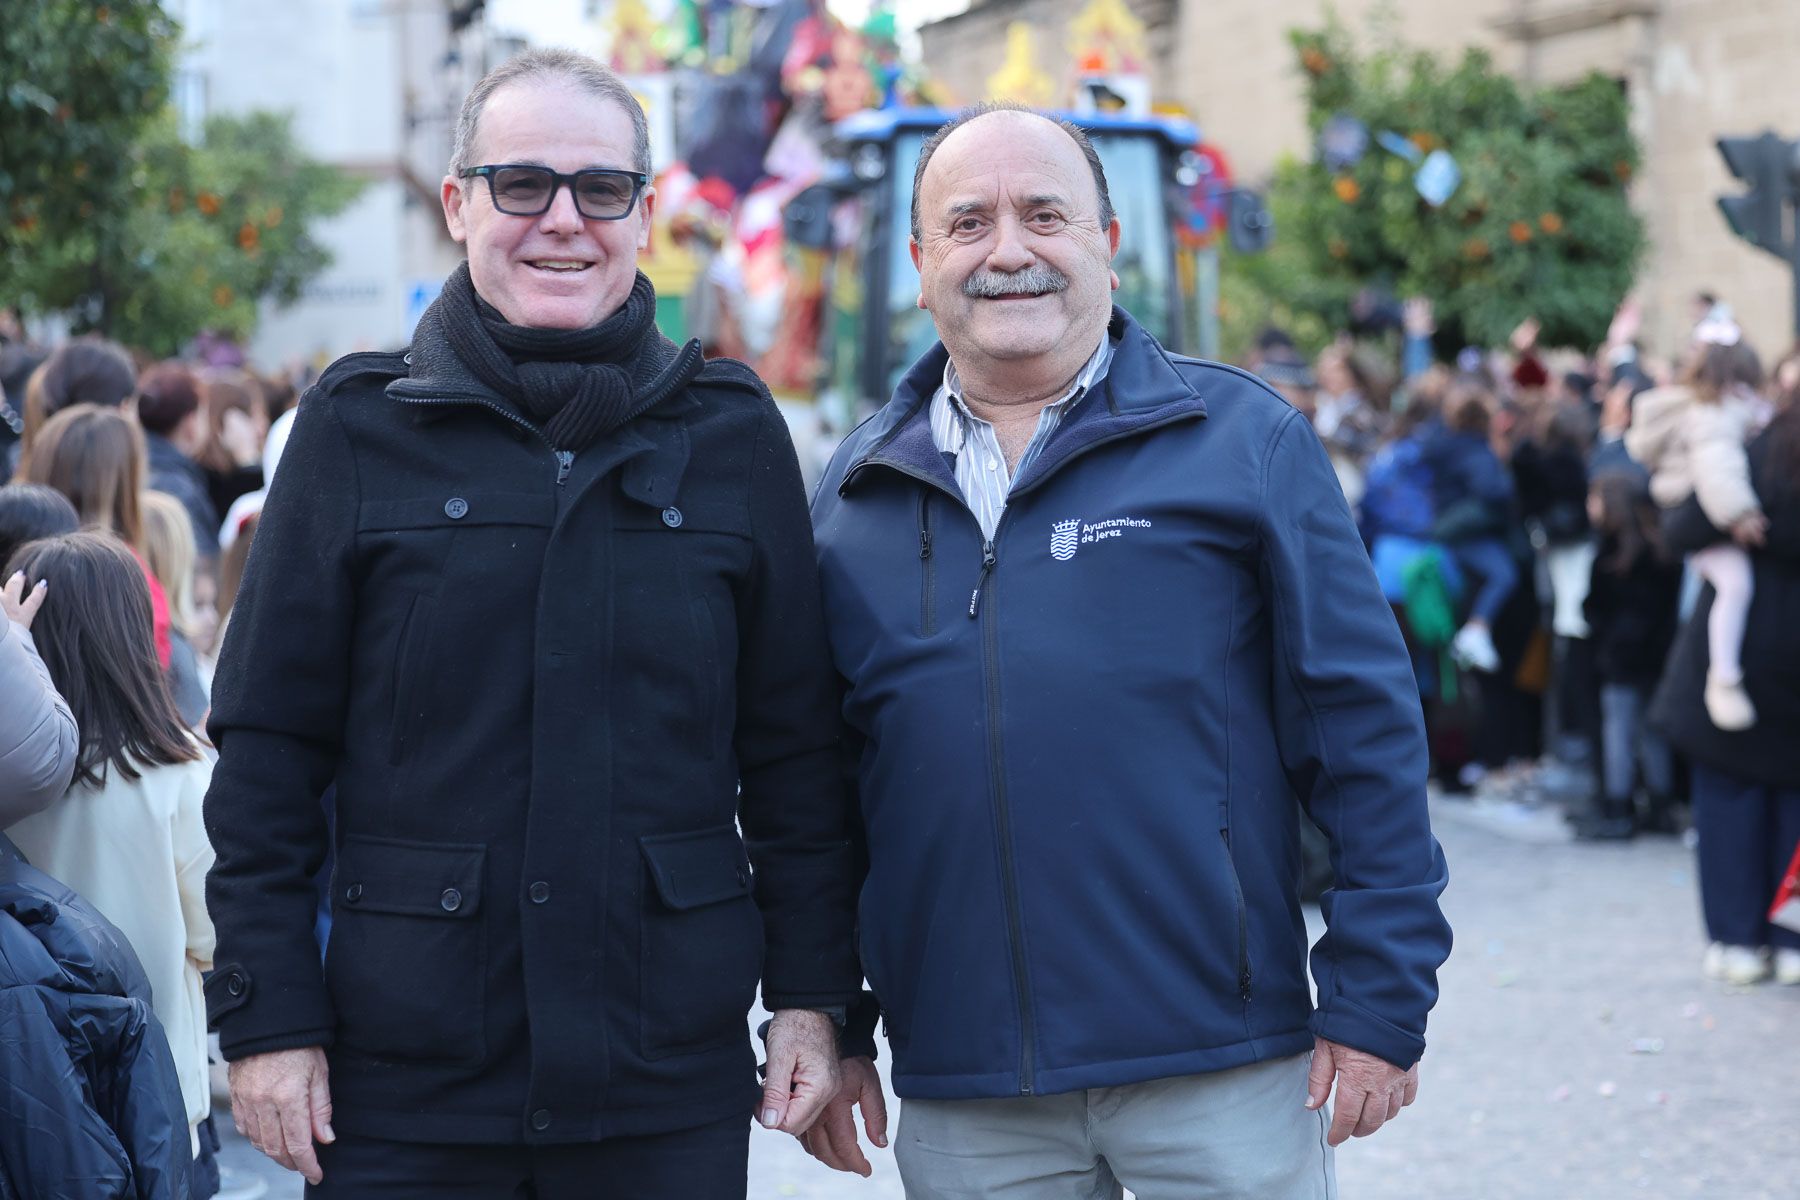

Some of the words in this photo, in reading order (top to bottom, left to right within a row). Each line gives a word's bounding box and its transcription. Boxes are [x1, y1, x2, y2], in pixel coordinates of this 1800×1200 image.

[1082, 517, 1152, 534] Ayuntamiento
[1081, 533, 1094, 544] de
[1095, 529, 1122, 543] Jerez
